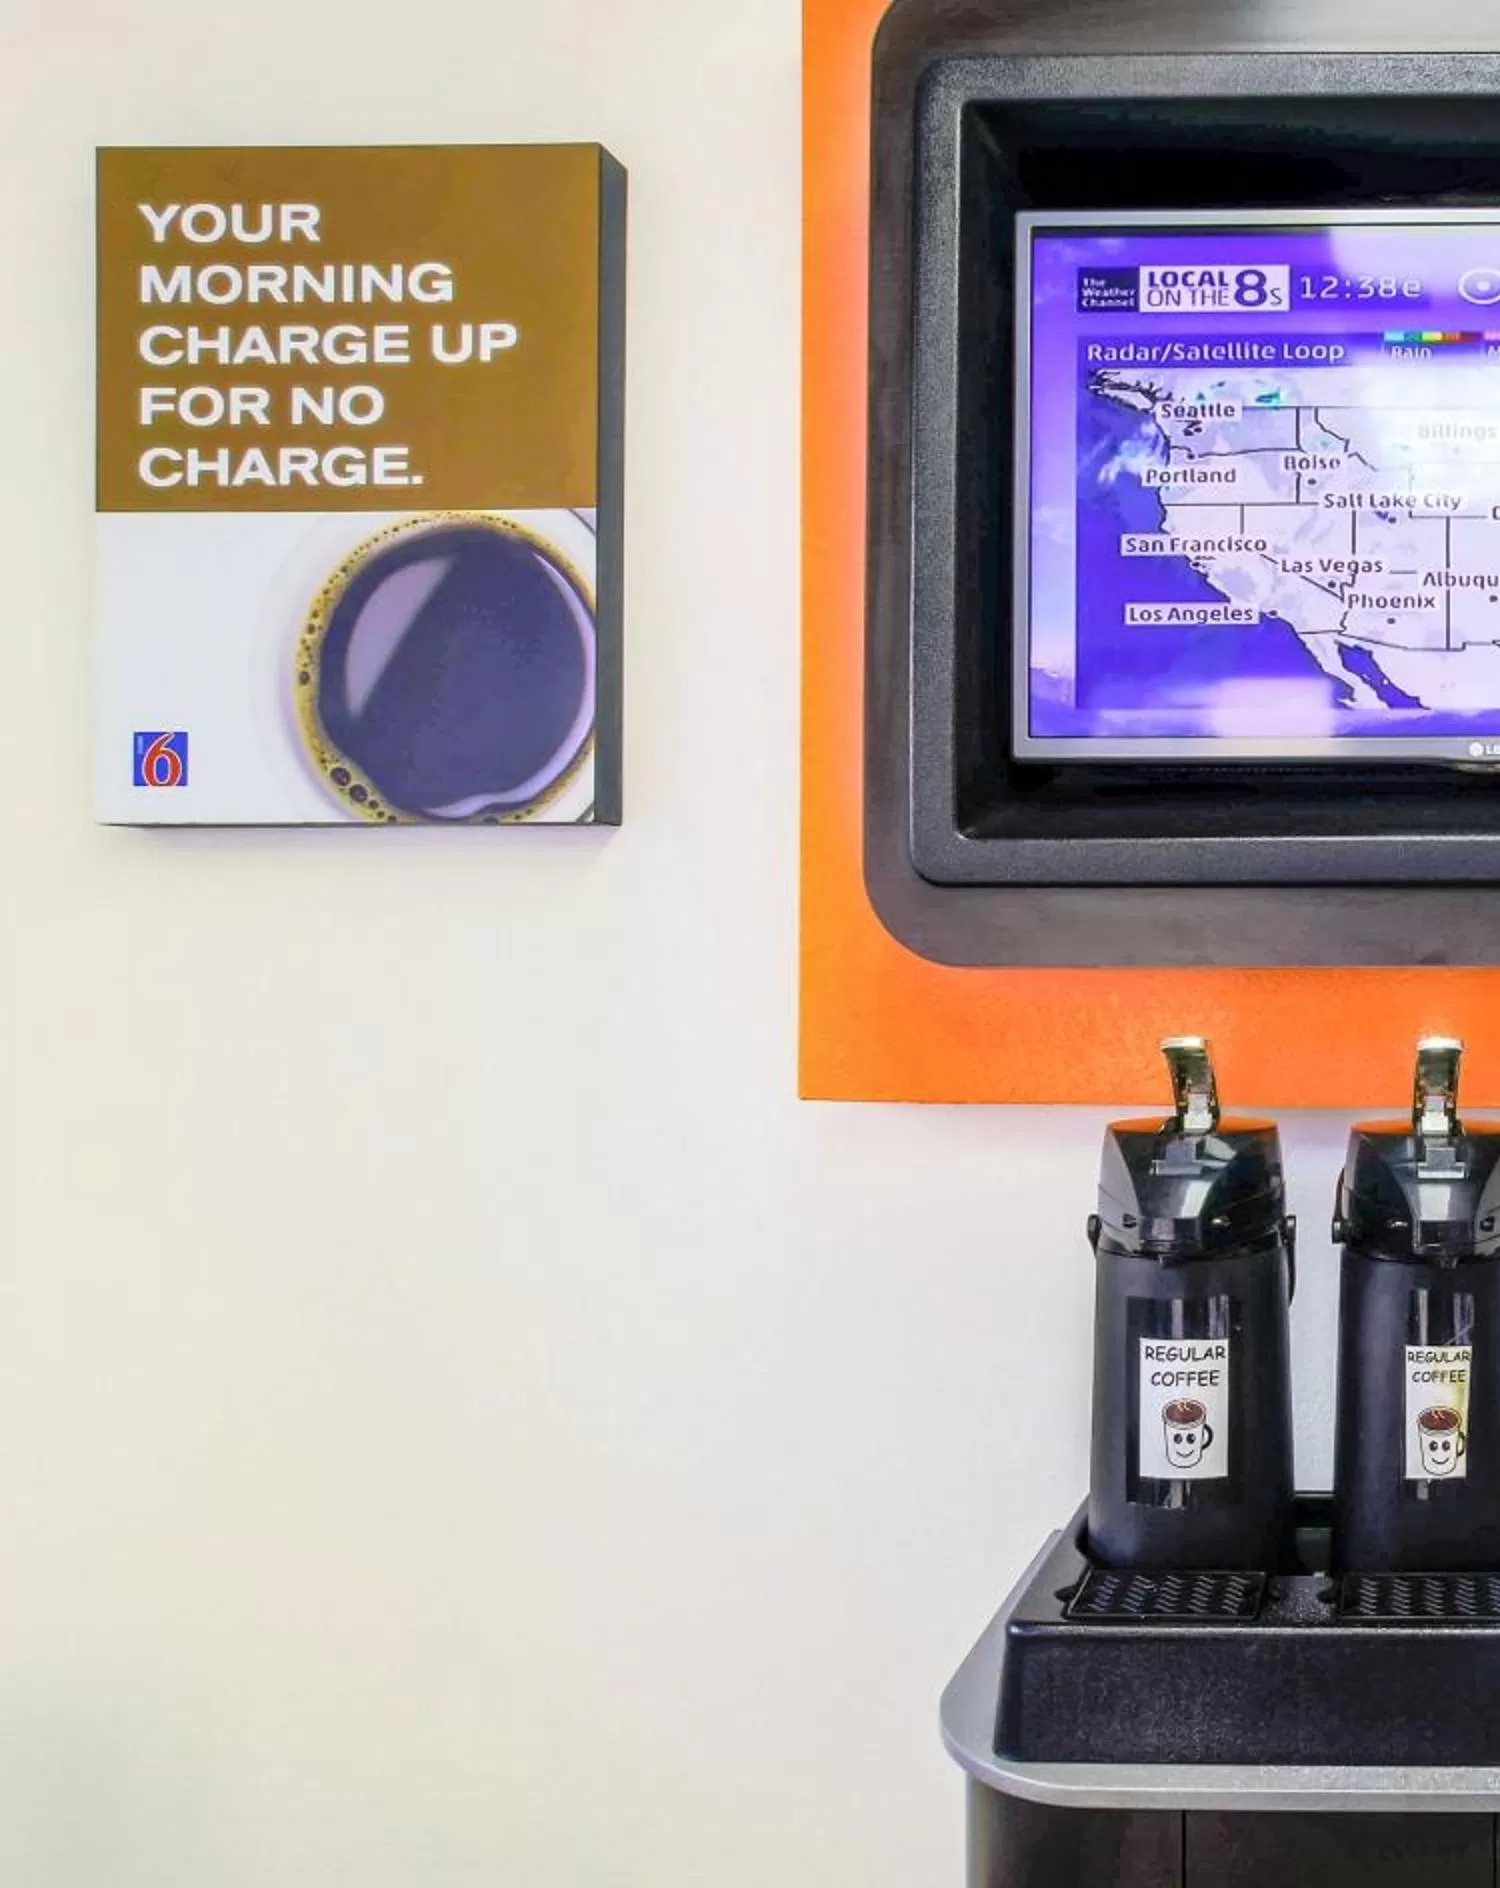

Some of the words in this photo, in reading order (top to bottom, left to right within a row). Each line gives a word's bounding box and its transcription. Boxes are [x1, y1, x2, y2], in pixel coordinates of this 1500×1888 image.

[138, 203, 321, 243] YOUR
[139, 263, 454, 304] MORNING
[1082, 277, 1106, 287] The
[1148, 271, 1229, 287] LOCAL
[1082, 287, 1135, 297] Weather
[1147, 289, 1180, 307] ON
[1186, 288, 1229, 306] THE
[1082, 297, 1135, 308] Channel
[138, 324, 410, 364] CHARGE
[431, 323, 518, 362] UP
[1391, 345, 1432, 360] Rain
[1087, 341, 1278, 362] Radar/Satellite
[1282, 342, 1345, 366] Loop
[139, 386, 271, 426] FOR
[290, 385, 385, 425] NO
[1161, 402, 1236, 420] Seattle
[1417, 423, 1498, 442] Billings
[138, 446, 423, 487] CHARGE.
[1284, 454, 1341, 471] Boise
[1146, 467, 1236, 485] Portland
[1324, 493, 1363, 509] Salt
[1369, 493, 1416, 509] Lake
[1423, 493, 1461, 512] City
[1125, 537, 1165, 553] San
[1170, 536, 1268, 553] Francisco
[1281, 558, 1313, 573] Las
[1319, 558, 1383, 578] Vegas
[1348, 593, 1436, 610] Phoenix
[1129, 606, 1164, 622] Los
[1170, 605, 1254, 625] Angeles
[142, 732, 182, 787] 6
[1145, 1346, 1226, 1361] REGULAR
[1407, 1350, 1471, 1363] REGULAR
[1151, 1370, 1220, 1386] COFFEE
[1411, 1369, 1466, 1383] COFFEE
